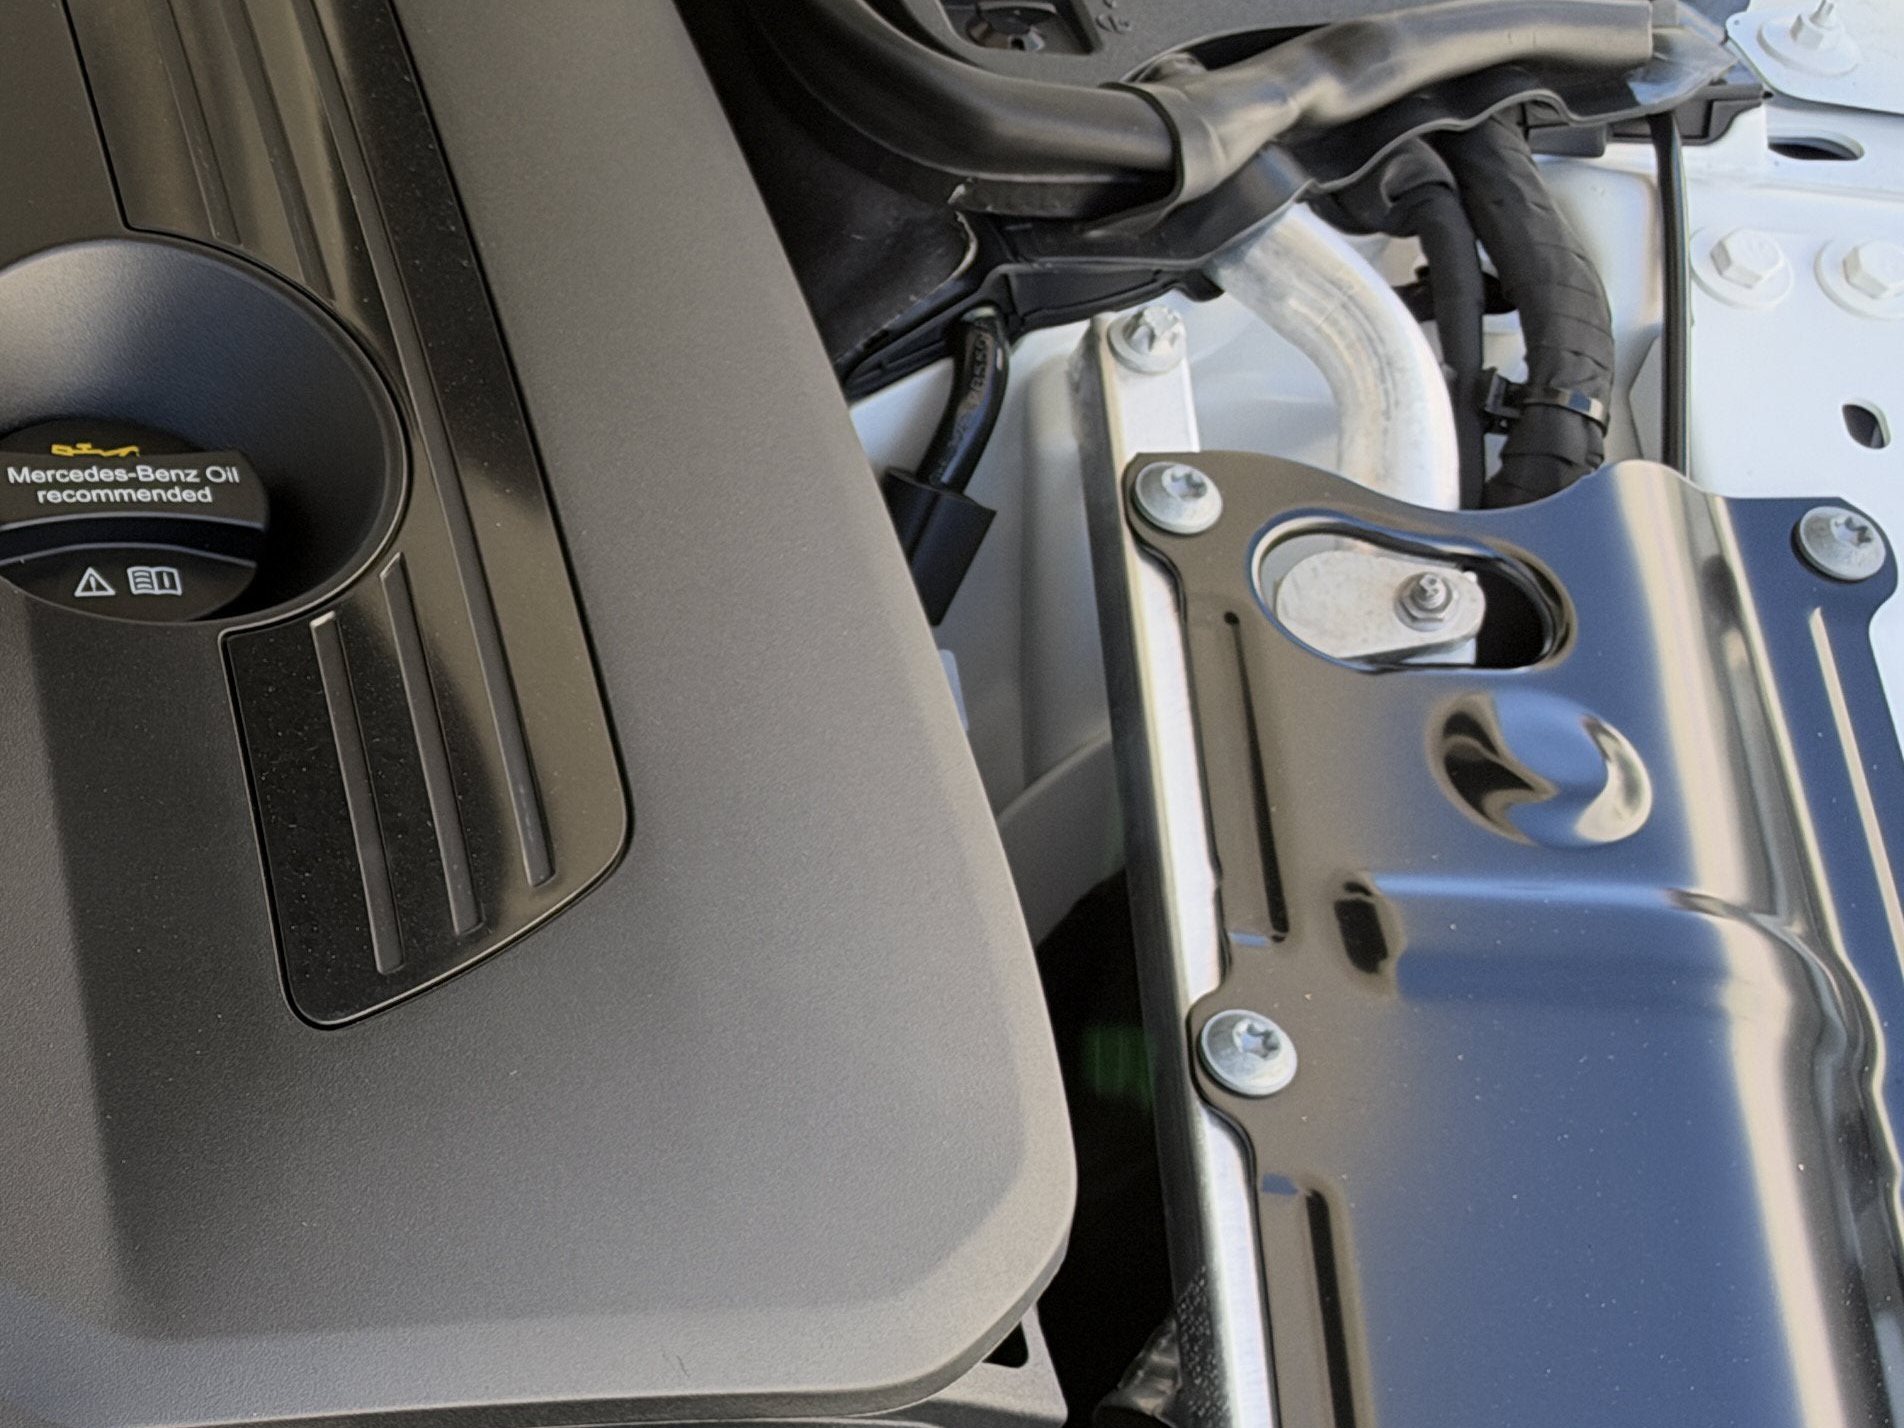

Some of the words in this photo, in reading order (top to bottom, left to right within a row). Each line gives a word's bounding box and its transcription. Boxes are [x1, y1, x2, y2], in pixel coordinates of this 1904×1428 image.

[6, 465, 200, 485] Mercedes-Benz
[204, 466, 240, 484] Oil
[36, 486, 213, 504] recommended
